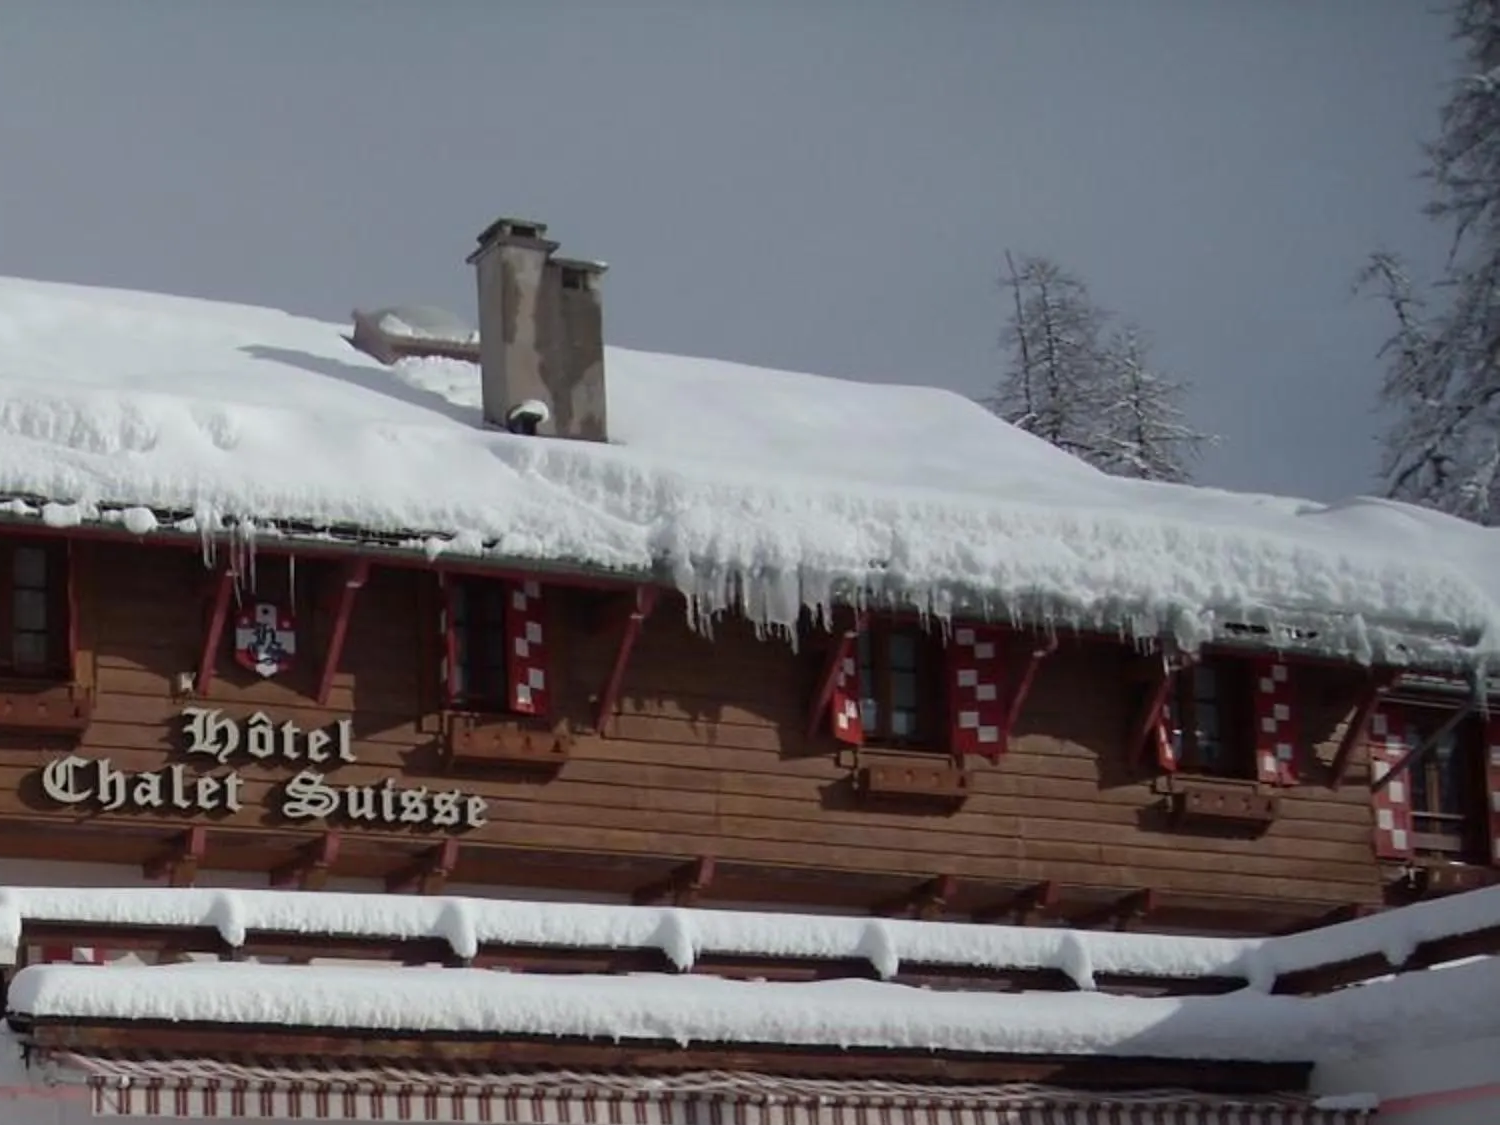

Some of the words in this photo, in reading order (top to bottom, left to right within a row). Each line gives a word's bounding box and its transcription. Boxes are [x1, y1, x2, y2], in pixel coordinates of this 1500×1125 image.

[181, 706, 358, 764] Hôtel
[41, 755, 245, 813] Chalet
[282, 769, 490, 828] Suisse
